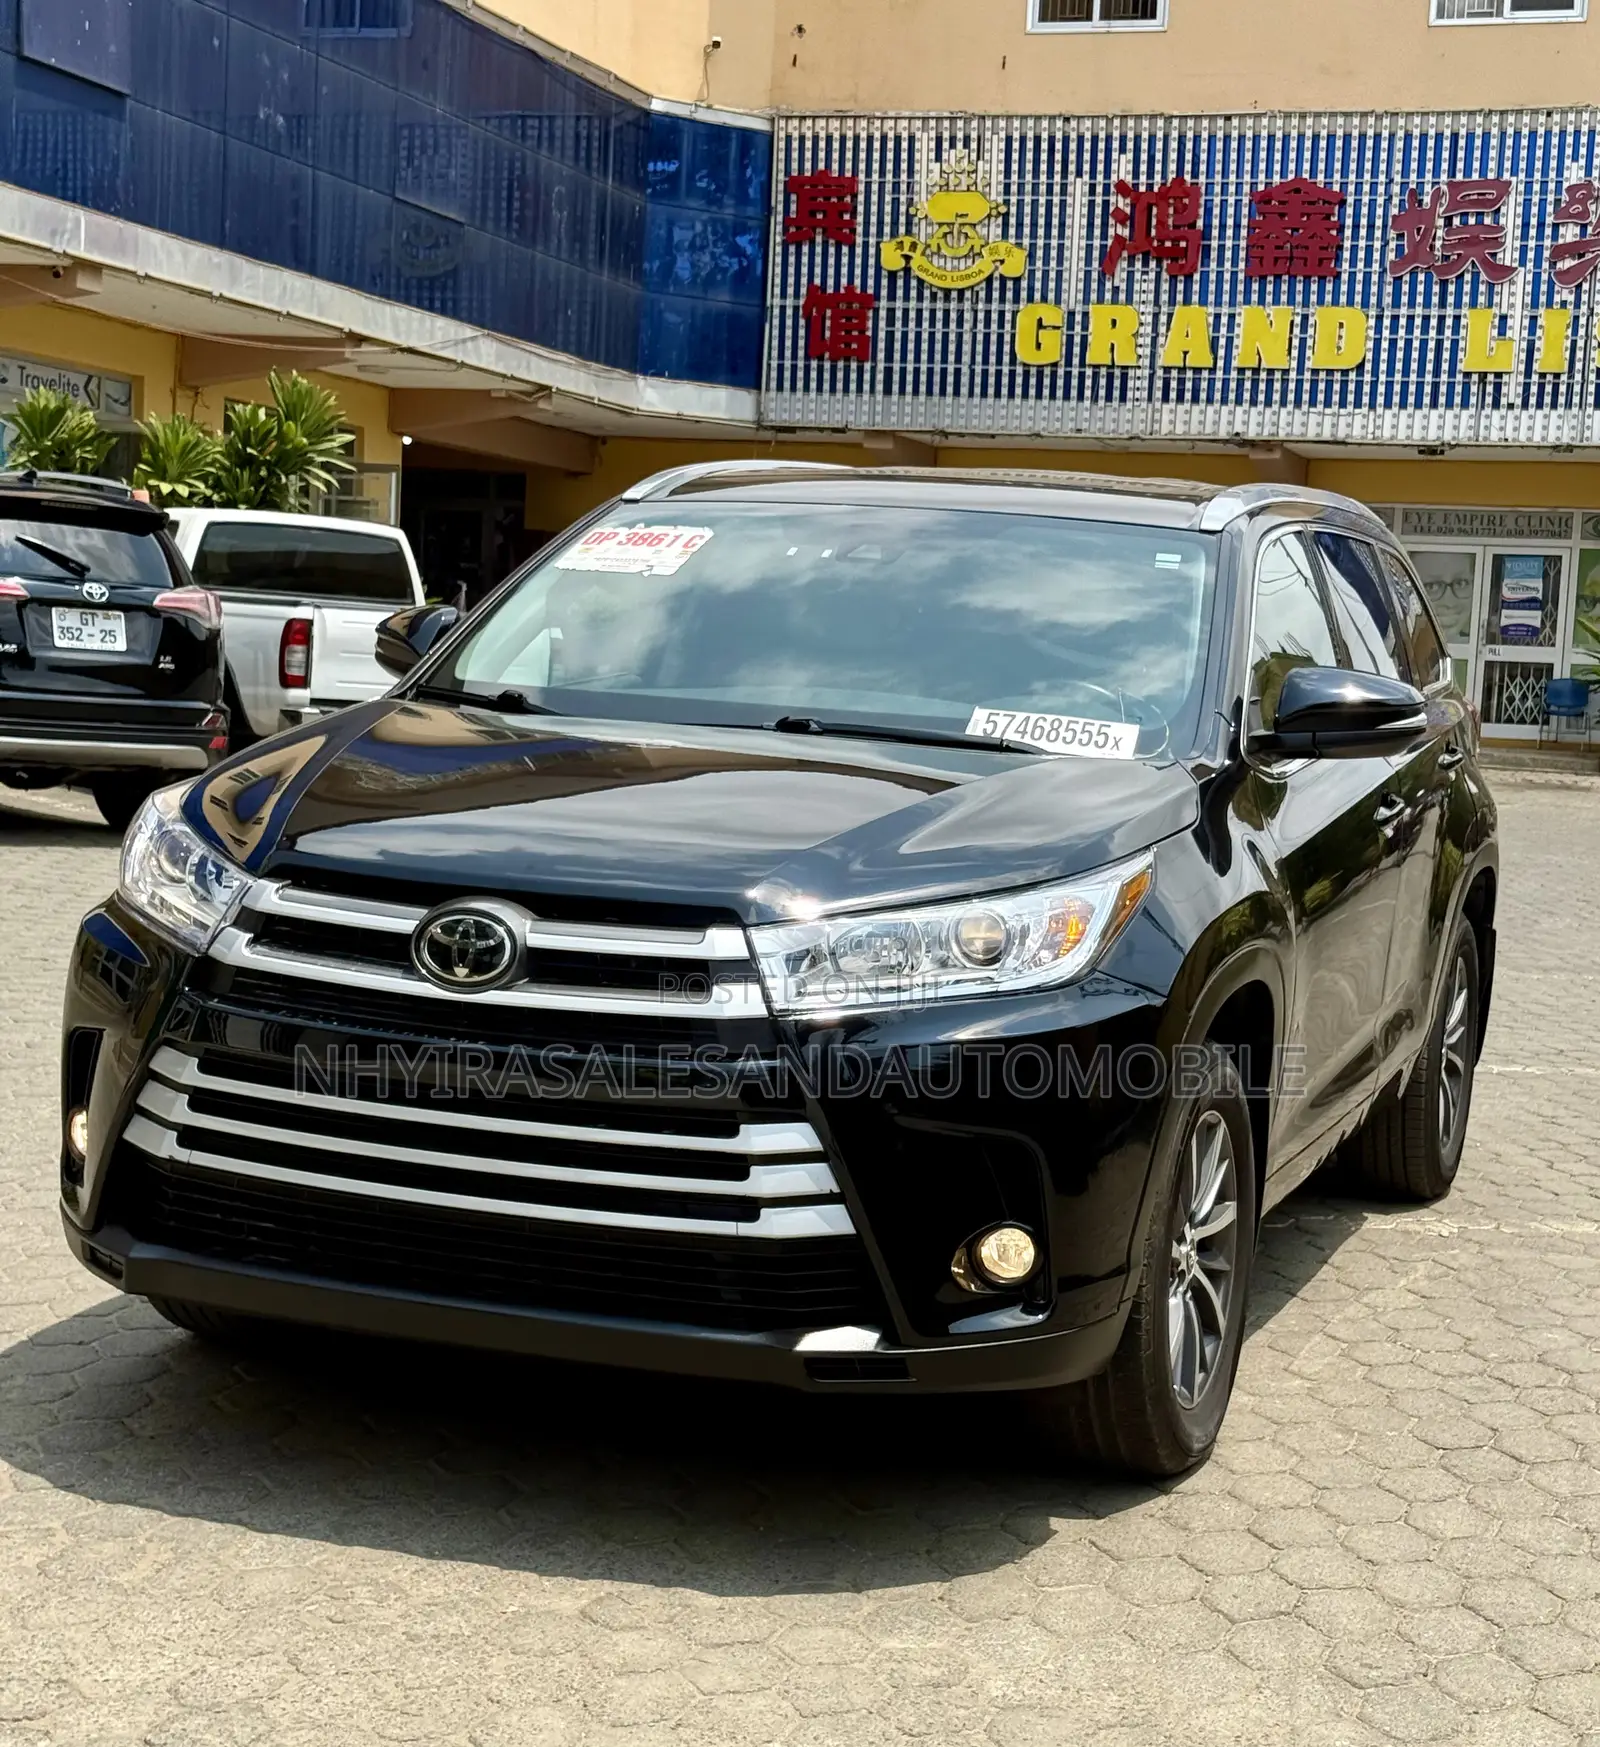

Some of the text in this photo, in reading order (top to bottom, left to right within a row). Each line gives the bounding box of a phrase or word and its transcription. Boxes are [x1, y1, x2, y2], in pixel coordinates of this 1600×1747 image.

[917, 264, 985, 282] GRAND LISBOA
[1014, 303, 1600, 374] GRAND LI
[17, 365, 79, 398] Travelite
[1404, 511, 1436, 525] EYE
[1442, 512, 1508, 527] EMPIRE
[582, 531, 619, 546] DP
[682, 534, 705, 549] C
[80, 611, 99, 627] GT
[58, 626, 84, 642] 352
[100, 629, 117, 644] 25
